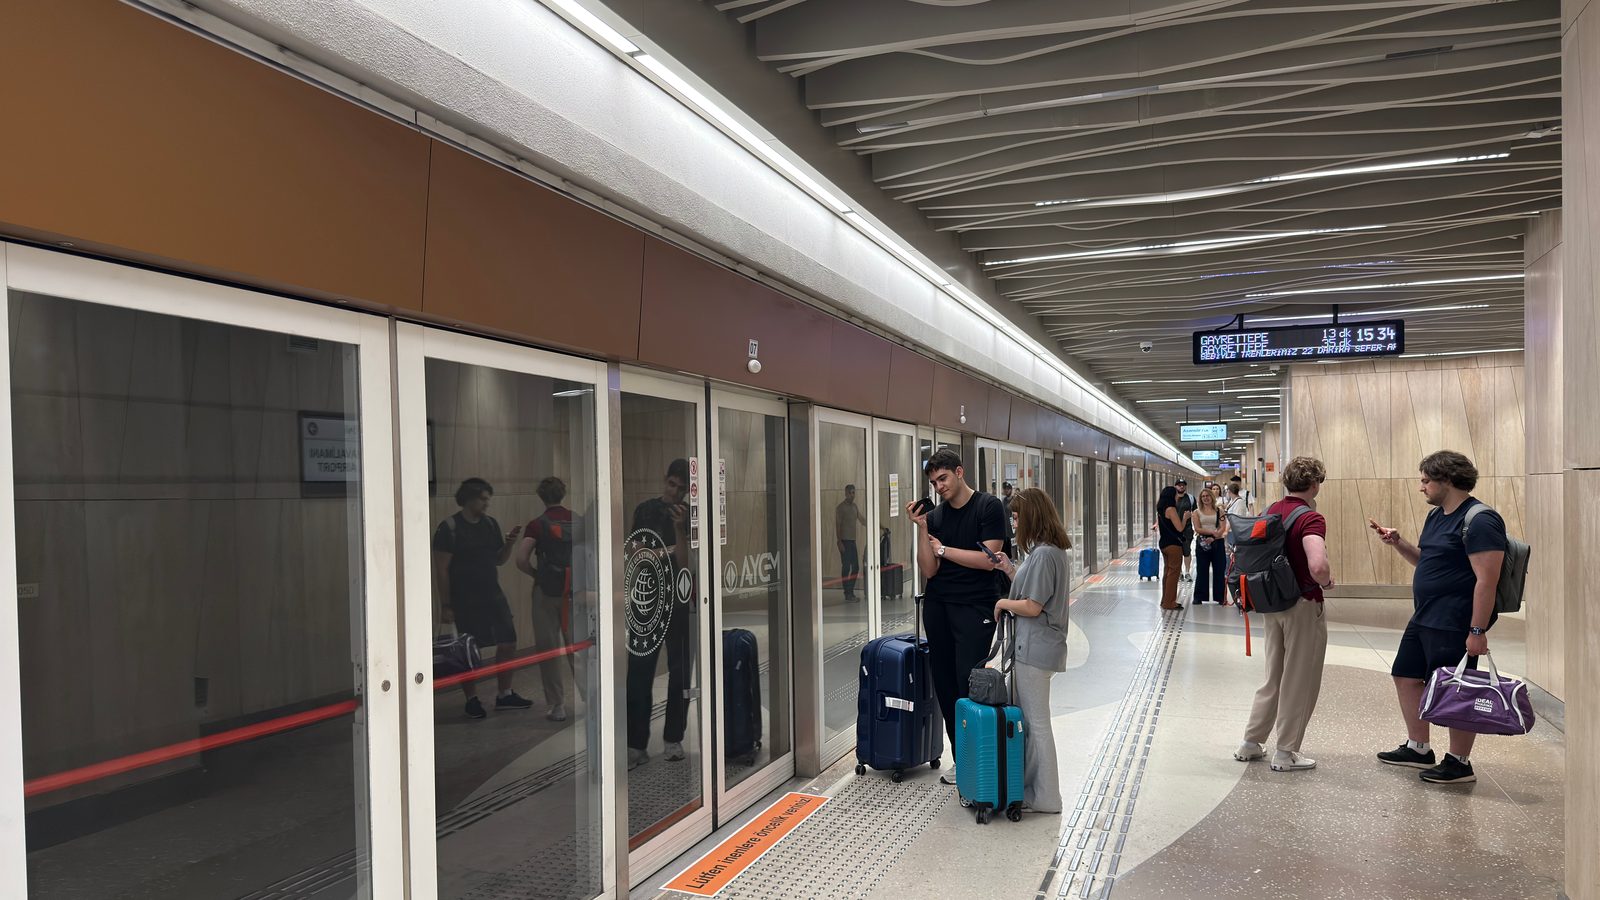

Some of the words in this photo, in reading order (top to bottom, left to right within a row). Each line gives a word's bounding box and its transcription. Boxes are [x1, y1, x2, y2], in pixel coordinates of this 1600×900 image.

[1201, 333, 1269, 345] GAYRETTEPE
[1323, 329, 1337, 339] 13
[1339, 328, 1352, 338] dk
[750, 342, 758, 355] 07
[1201, 342, 1269, 354] GAYRETTEPE
[1322, 338, 1337, 348] 35
[1339, 338, 1352, 348] dk
[740, 551, 780, 587] AYGM
[686, 864, 727, 889] Lütfen
[718, 837, 761, 865] inenlere
[754, 815, 789, 837] öncelik
